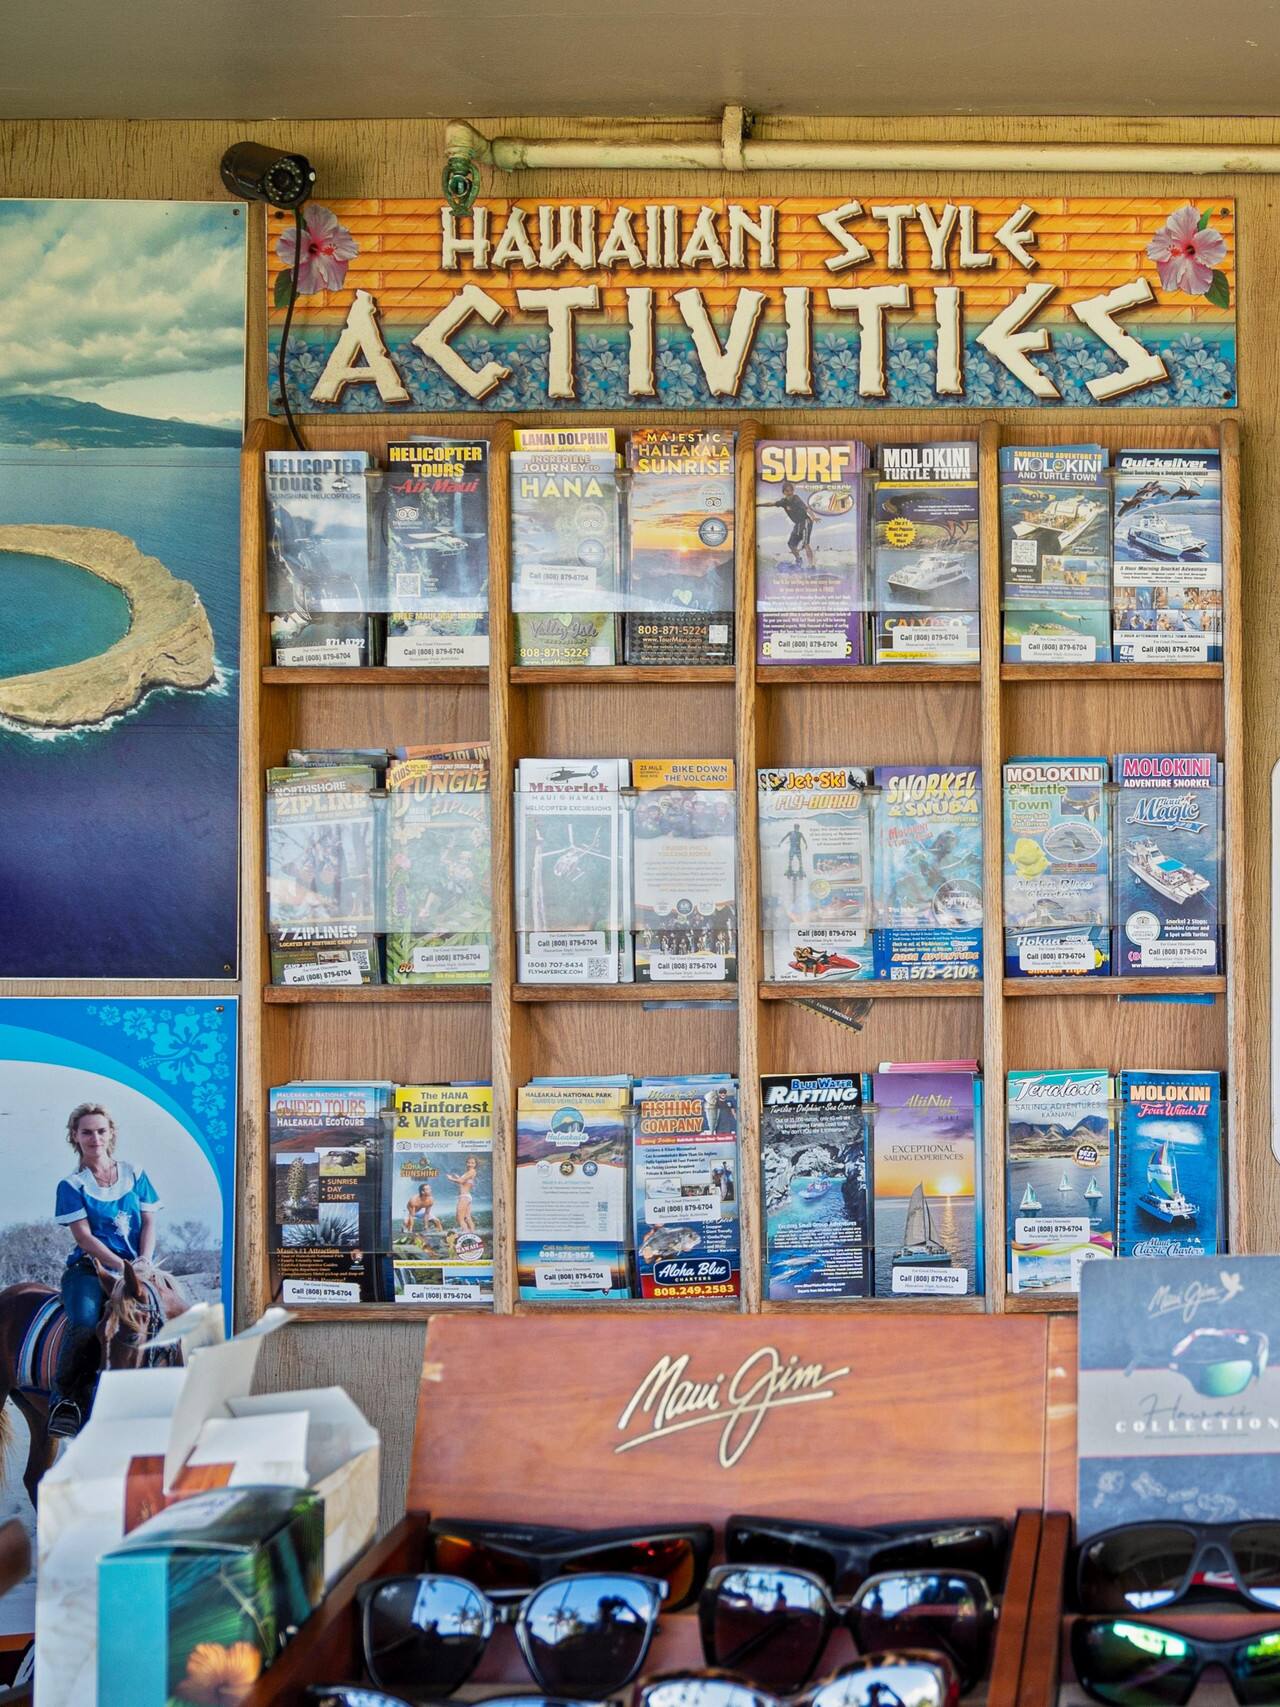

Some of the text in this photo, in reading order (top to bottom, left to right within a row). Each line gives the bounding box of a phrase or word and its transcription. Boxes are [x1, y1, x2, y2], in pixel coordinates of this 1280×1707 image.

[440, 200, 1039, 271] HAWAIIAN STYLE
[311, 278, 1169, 402] ACTIVITIES
[522, 432, 608, 446] LANAI DOLPHIN
[647, 433, 721, 443] MAJESTIC
[390, 447, 482, 461] HELICOPTER
[531, 455, 592, 463] INCREDIBLE
[883, 448, 970, 468] MOLOKINI
[268, 458, 363, 475] HELICOPTER
[522, 463, 585, 472] JOURNEY
[638, 459, 730, 475] SUNRISE
[761, 446, 851, 483] SURF
[1014, 457, 1101, 472] MOLOKINI
[1121, 457, 1207, 469] Quicksilver
[411, 463, 465, 477] TOURS
[885, 468, 971, 480] TURTLE TOWN
[1039, 472, 1070, 480] TURTLE
[1072, 473, 1097, 481] TOWN
[269, 477, 322, 491] TOURS
[431, 478, 480, 493] Maui
[638, 625, 708, 635] 808-871-5224
[792, 641, 808, 649] (808)
[519, 648, 589, 657] 808-871-5224
[671, 765, 728, 773] BIKE DOWN
[1123, 758, 1211, 777] MOLOKINI
[664, 774, 682, 782] THE
[1007, 766, 1100, 783] MOLOKINI
[274, 781, 347, 798] NORTHSHORE
[528, 783, 609, 793] Maverick
[887, 771, 976, 804] SNORKEL
[1123, 779, 1210, 789] ADVENTURE SNORKEL
[394, 769, 490, 817] JUNGLE
[276, 793, 369, 817] ZIPLINE
[776, 793, 861, 810] FLY-BOARD
[1010, 799, 1053, 810] Town
[904, 800, 979, 816] SNUBA
[1127, 797, 1200, 826] Magic
[278, 925, 357, 941] 7 ZIPLINES
[551, 940, 567, 948] (808)
[569, 939, 598, 947] 879-6704
[1016, 935, 1062, 946] Hokua
[1040, 952, 1056, 960] (808)
[658, 961, 717, 970] Call (808) 879-6704
[911, 965, 979, 979] 573-2104
[292, 975, 305, 983] Call
[791, 1078, 853, 1090] BLUE WATER
[1015, 1074, 1102, 1101] Teralani
[420, 1091, 469, 1100] The HANA
[767, 1086, 859, 1104] RAFTING
[1130, 1086, 1211, 1101] MOLOKINI
[276, 1099, 366, 1118] GUIDED TOURS
[401, 1101, 489, 1113] Rainforest
[640, 1100, 702, 1118] FISHING
[1016, 1102, 1101, 1112] SAILING ADVENTURES
[1137, 1101, 1197, 1118] Four Winds
[276, 1117, 323, 1127] HALEAKALA
[398, 1115, 491, 1128] & Waterfall
[640, 1117, 703, 1134] COMPANY
[422, 1129, 465, 1137] Fun Tour
[413, 1141, 450, 1149] tripadvisor
[891, 1145, 955, 1153] EXCEPTIONAL
[914, 1153, 964, 1161] EXPERIENCES
[1079, 1149, 1096, 1157] BEST
[667, 1205, 683, 1213] (808)
[684, 1203, 713, 1211] 879-6704
[1023, 1225, 1036, 1233] Call
[1037, 1225, 1053, 1233] (808)
[1131, 1243, 1166, 1257] Classic
[658, 1262, 727, 1279] Aloha Blue
[913, 1275, 930, 1283] (808)
[931, 1275, 959, 1283] 879-6704
[305, 1287, 322, 1296] (808)
[411, 1291, 425, 1299] Call
[425, 1291, 443, 1299] (808)
[653, 1284, 734, 1296] 808.249.2583
[617, 1346, 850, 1468] Maui Jim
[1115, 1417, 1279, 1434] COLLECTION
